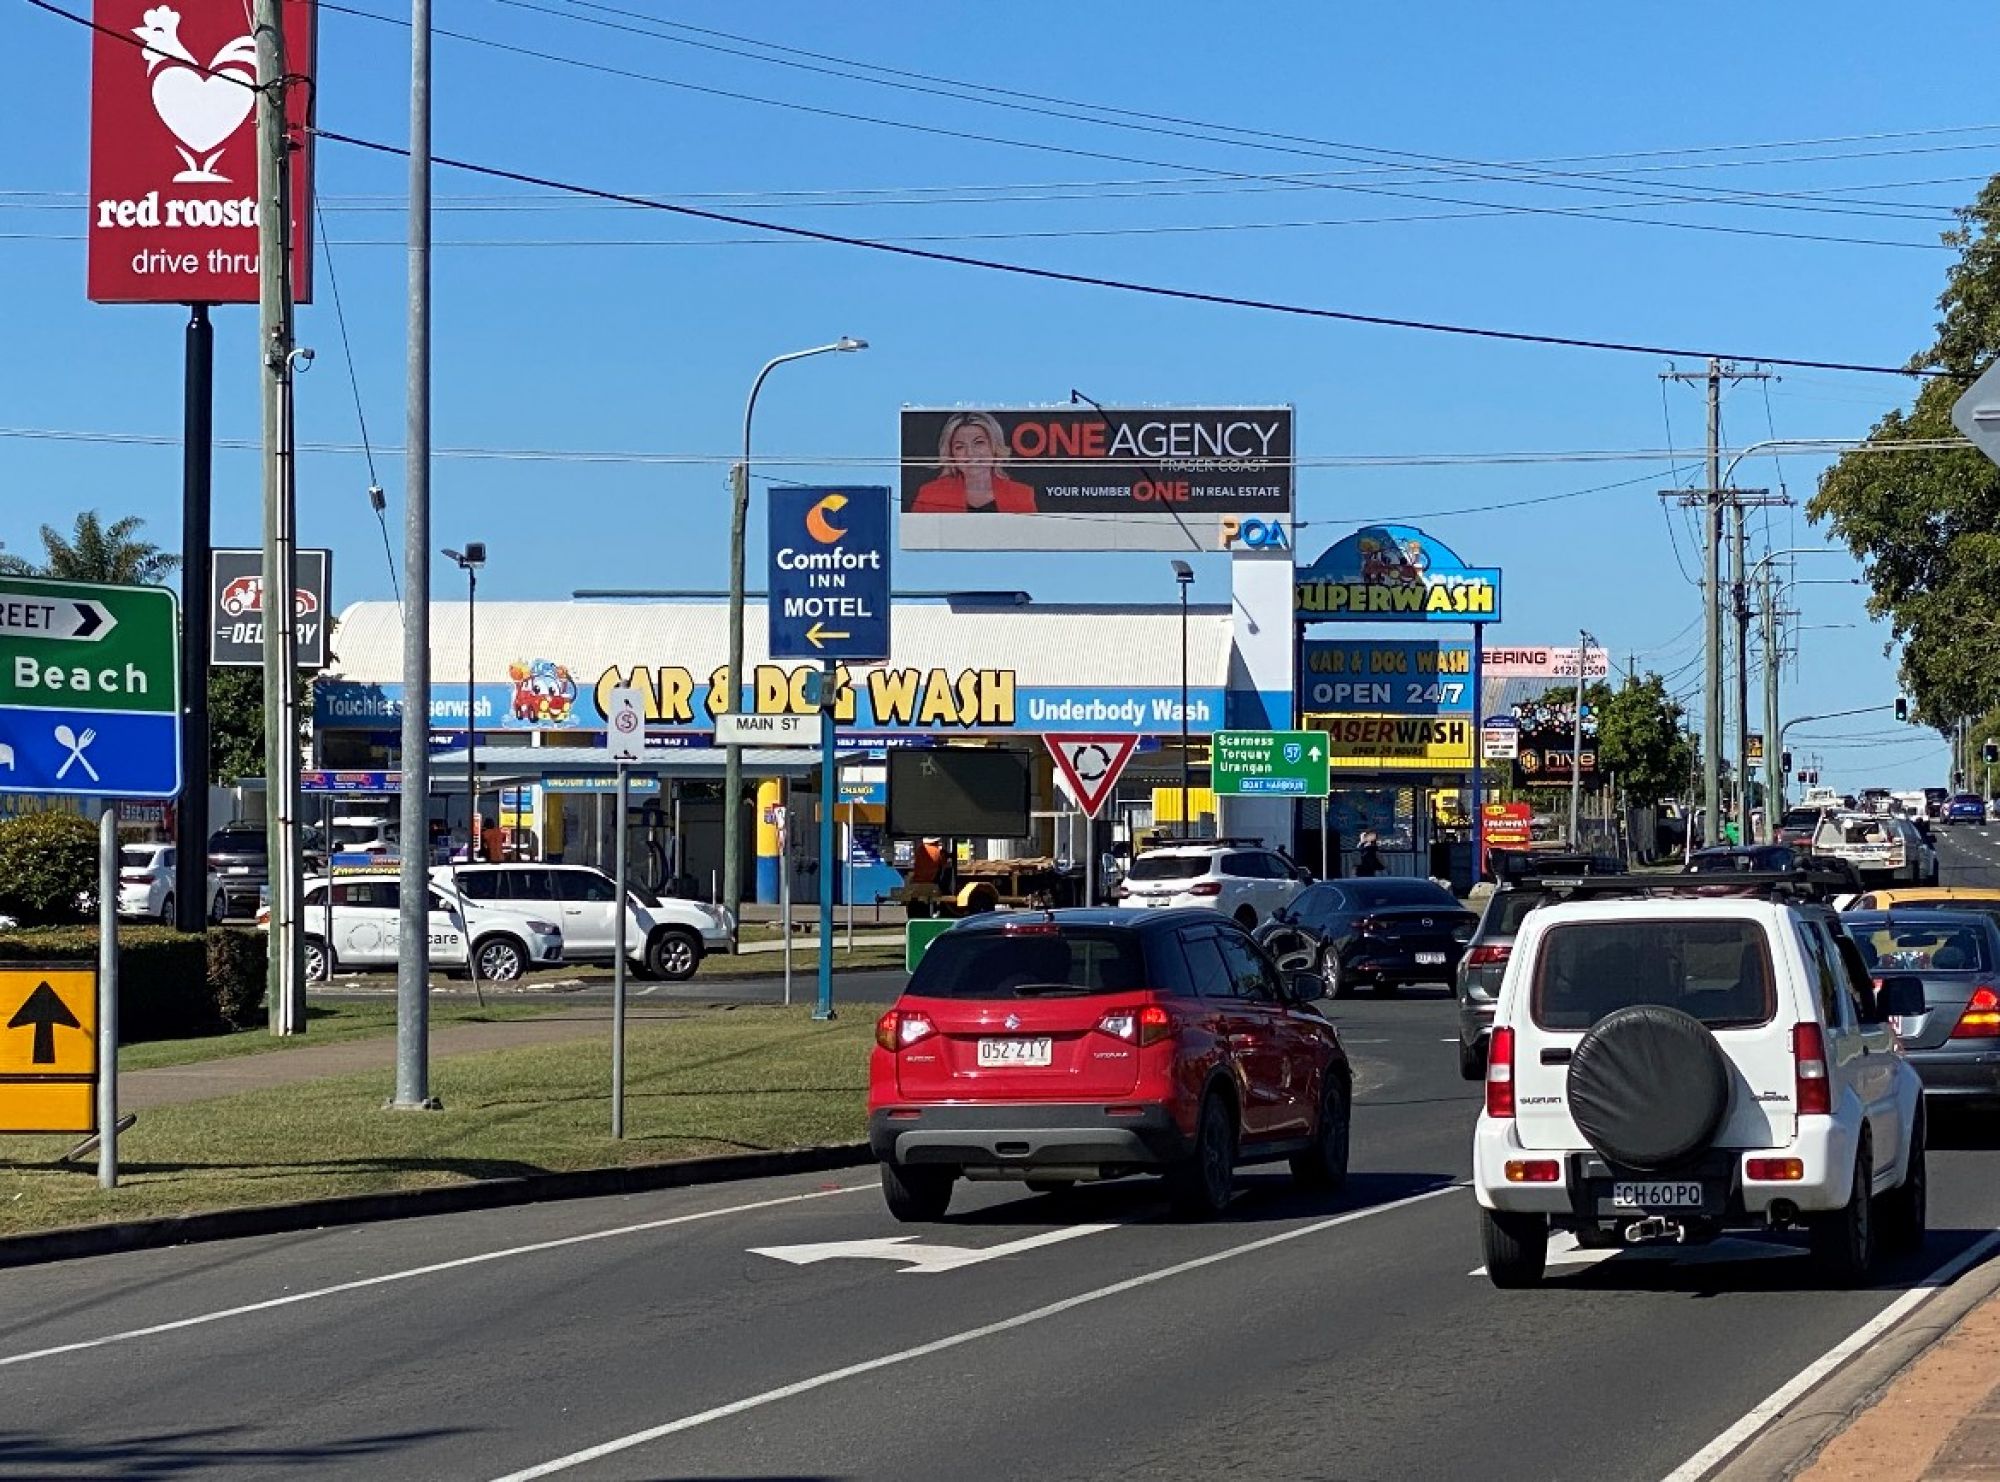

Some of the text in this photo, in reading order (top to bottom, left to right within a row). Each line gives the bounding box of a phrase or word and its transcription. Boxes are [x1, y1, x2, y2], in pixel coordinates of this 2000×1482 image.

[97, 191, 262, 228] red roost
[132, 248, 260, 274] drive thru
[1011, 421, 1279, 457] ONE AGENCY
[1046, 481, 1280, 501] YOUR NUMBER ONE IN REAL ESTATE
[1219, 516, 1290, 550] POA
[777, 547, 880, 570] Comfort
[809, 574, 846, 587] INN
[0, 602, 55, 630] EET
[784, 598, 872, 618] MOTEL
[232, 623, 318, 645] DELRY
[15, 656, 148, 693] Beach
[1310, 650, 1345, 673] CAR
[1371, 650, 1408, 673] DOG
[1416, 650, 1470, 675] WASH
[867, 667, 1016, 728] WASH
[1313, 683, 1465, 704] OPEN 24/7
[736, 717, 800, 731] MAIN ST
[1029, 698, 1210, 726] Underbody Wash
[1220, 748, 1271, 761] Torquay
[1220, 762, 1273, 775] Urangan
